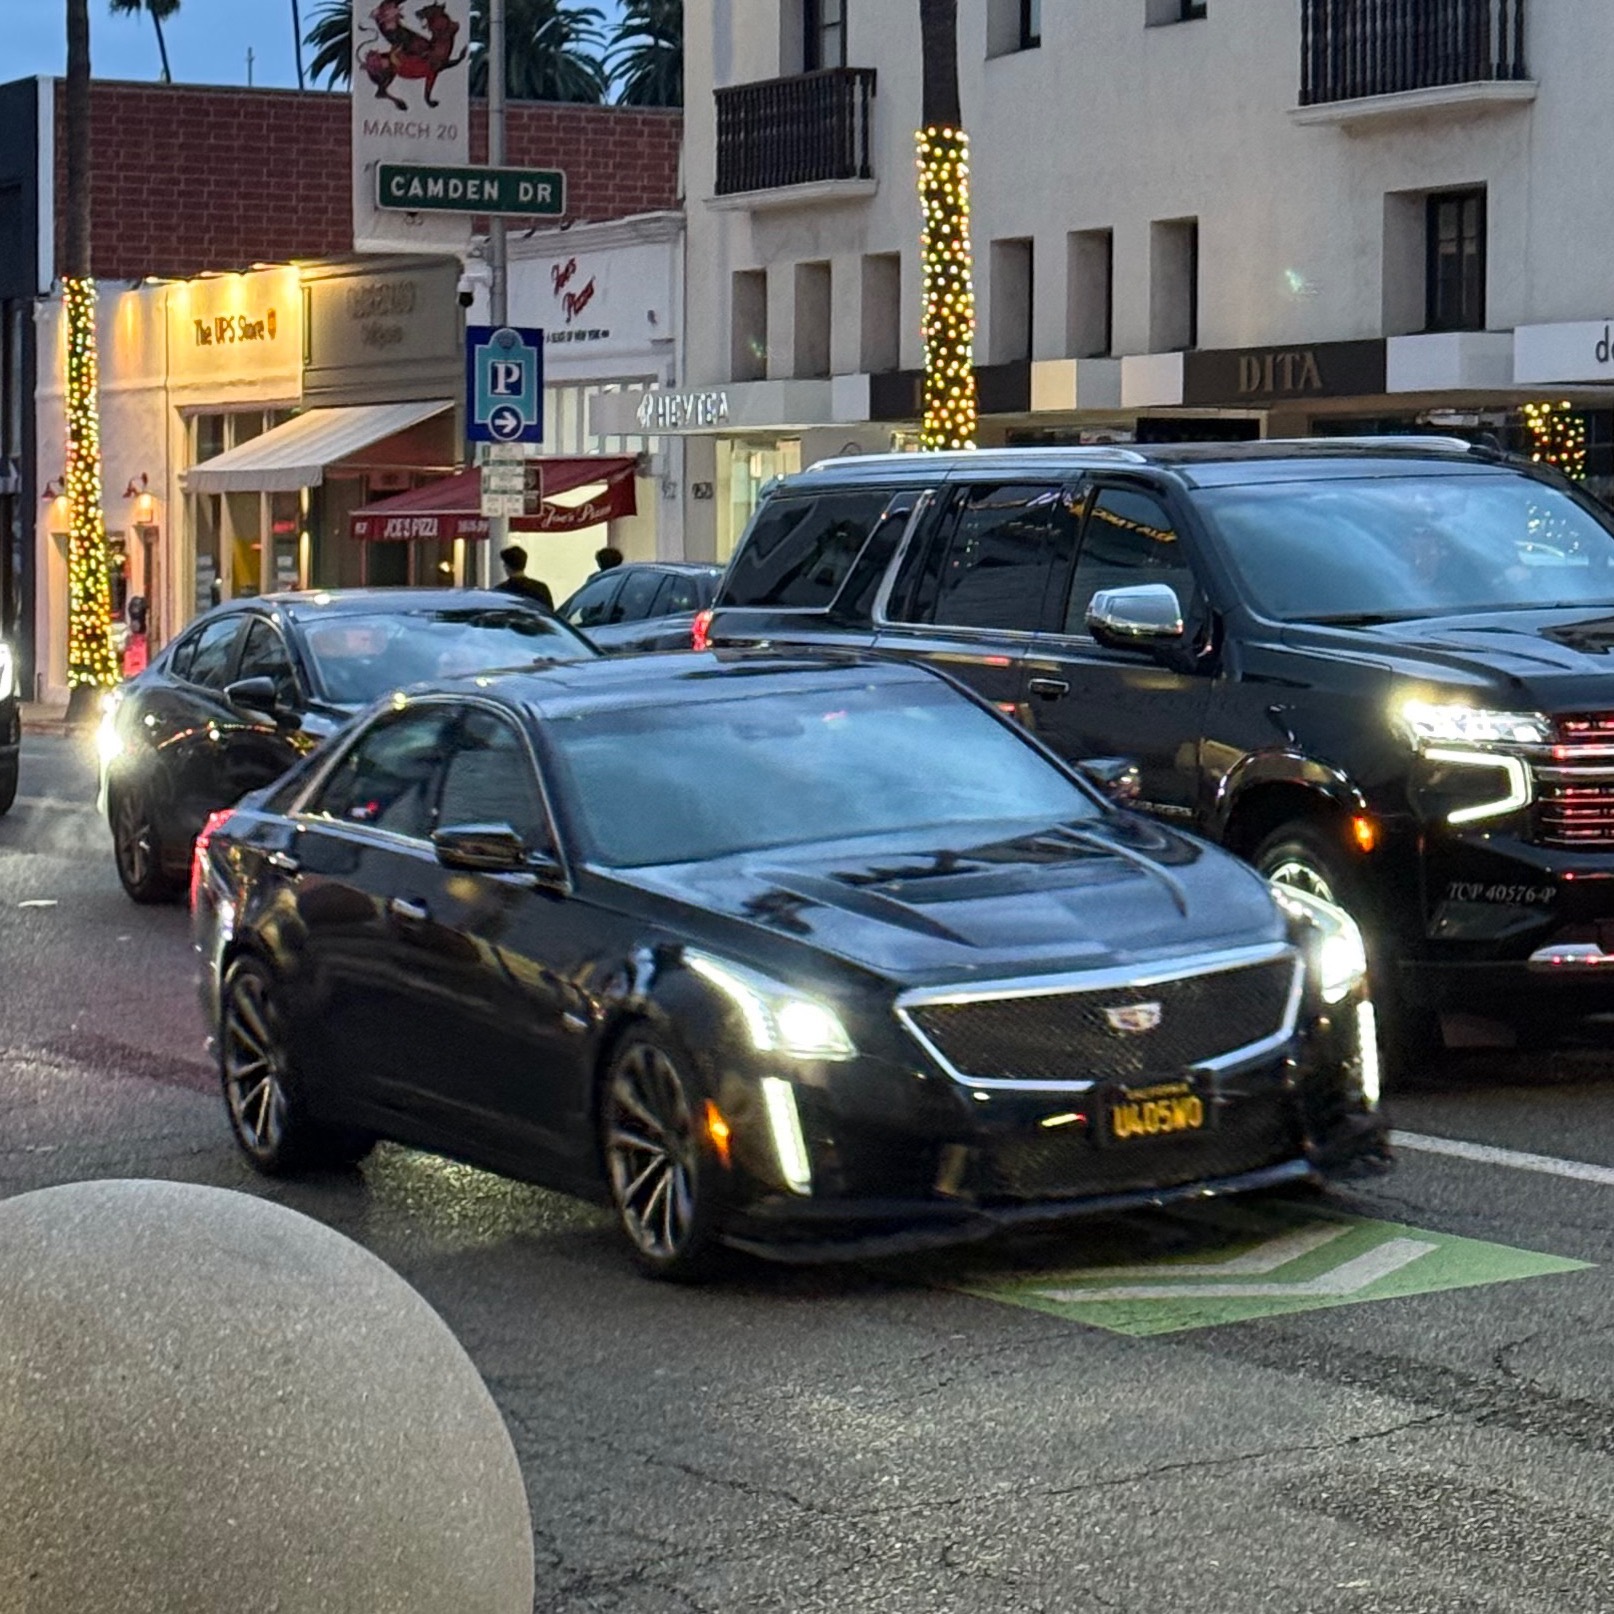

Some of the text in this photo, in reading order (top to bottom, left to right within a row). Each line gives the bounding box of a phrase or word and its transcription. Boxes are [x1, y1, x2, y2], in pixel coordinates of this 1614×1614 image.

[363, 119, 458, 140] MARCH 20
[390, 176, 552, 203] CAMDEN DR
[193, 315, 265, 346] The UPS Store
[493, 362, 520, 394] P
[1238, 350, 1322, 393] DITA
[1449, 882, 1484, 900] TCP
